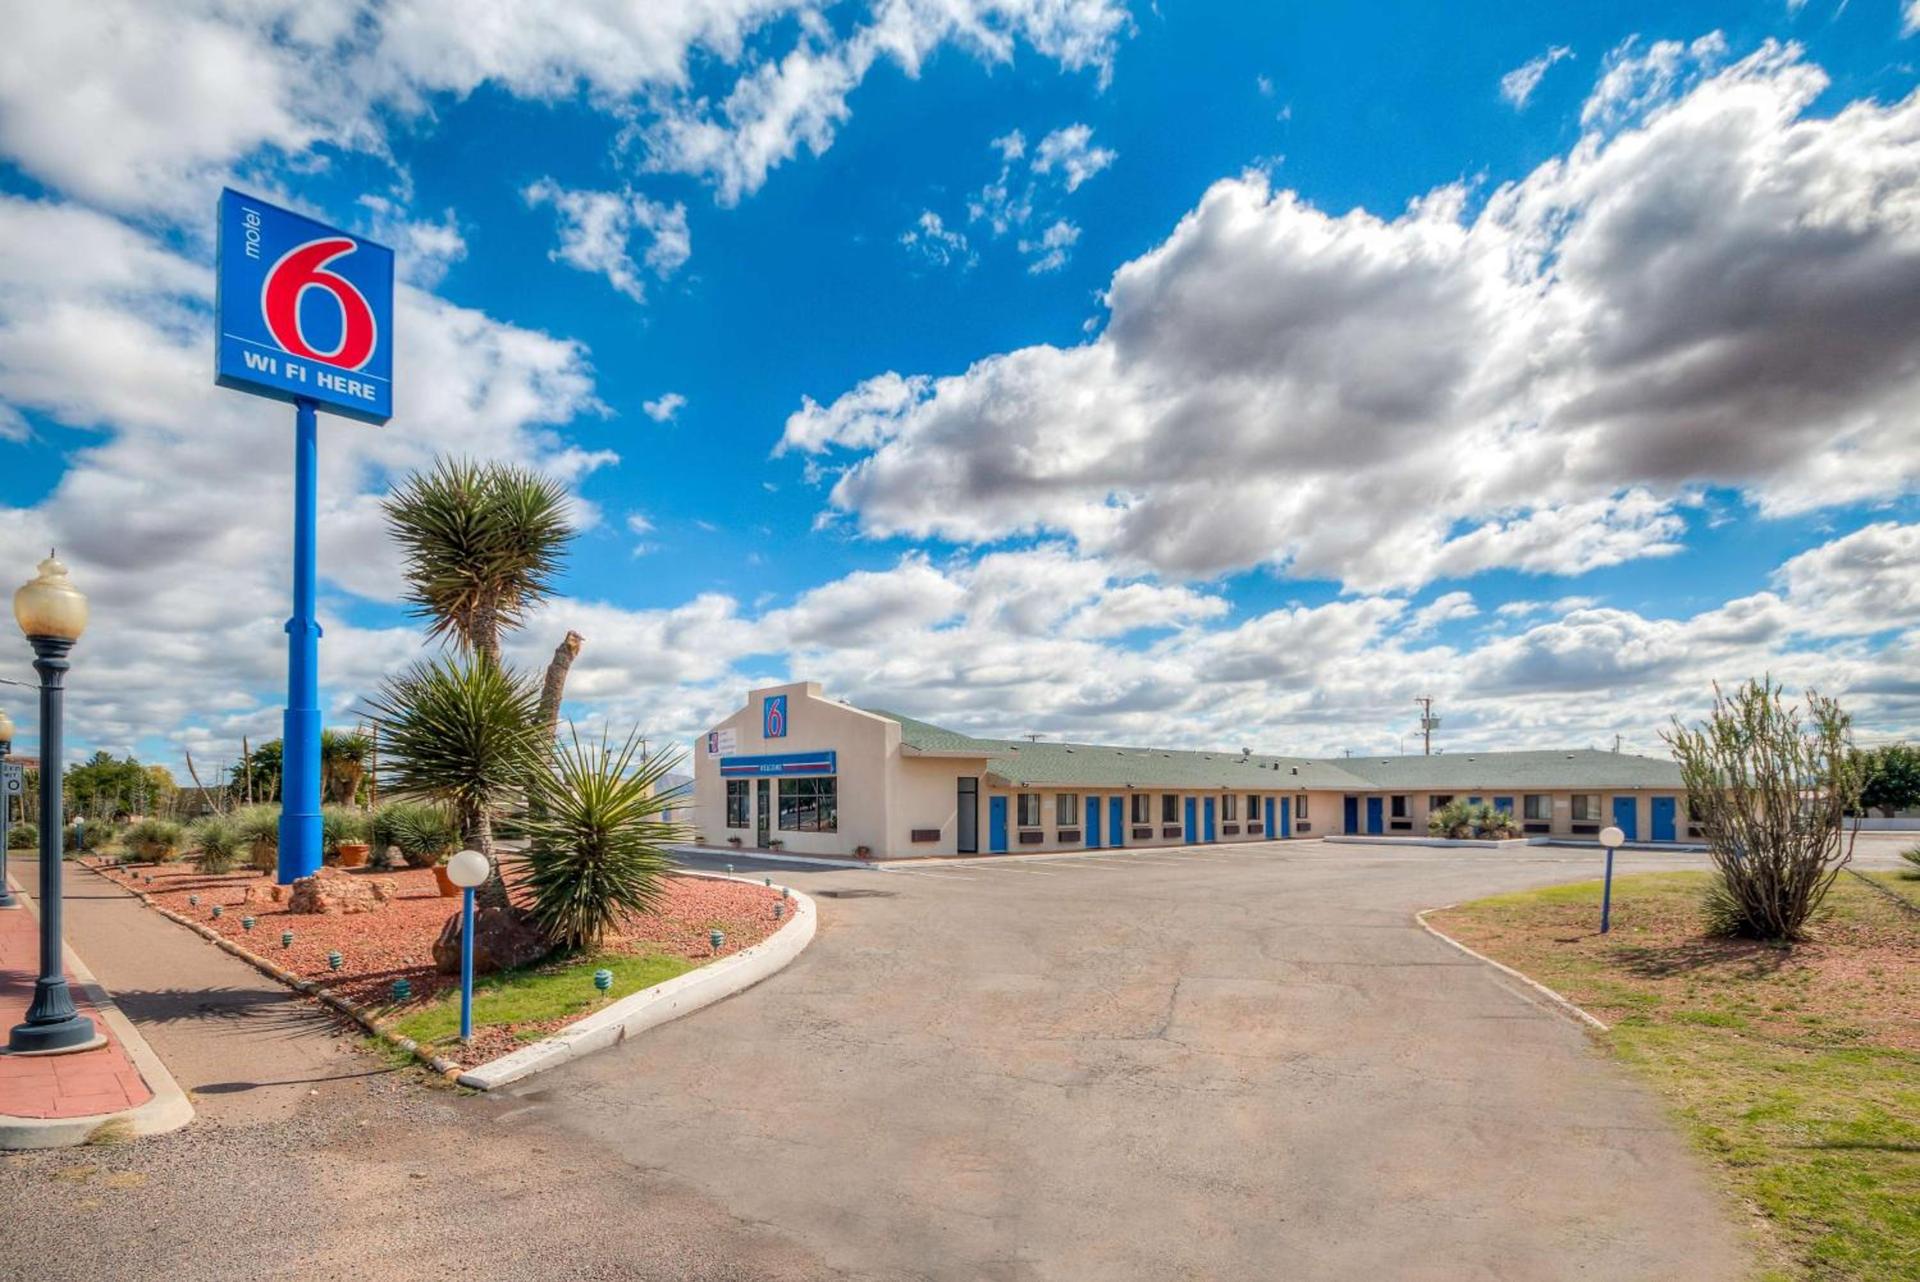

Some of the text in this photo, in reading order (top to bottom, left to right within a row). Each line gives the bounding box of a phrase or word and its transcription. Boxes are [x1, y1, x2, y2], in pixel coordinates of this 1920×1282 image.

[241, 206, 261, 260] motel
[261, 236, 377, 371] 6
[243, 350, 376, 401] WI FI HERE
[768, 697, 783, 737] 6
